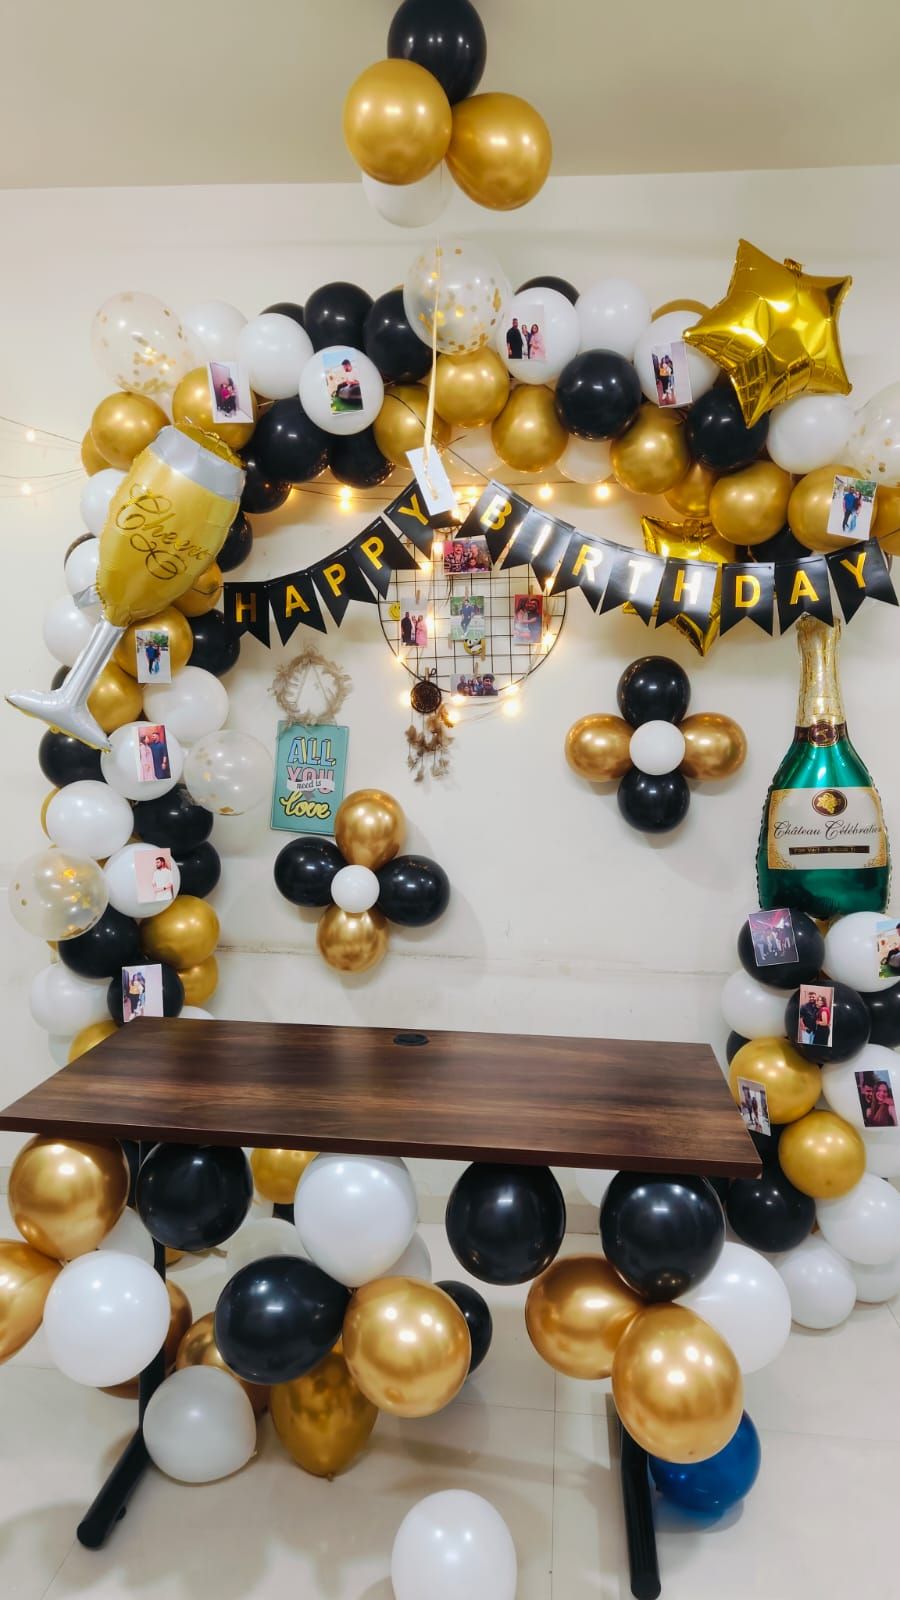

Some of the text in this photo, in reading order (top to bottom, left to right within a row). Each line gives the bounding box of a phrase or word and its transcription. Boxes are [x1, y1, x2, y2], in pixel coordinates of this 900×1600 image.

[116, 484, 209, 580] Cheers
[235, 493, 868, 623] HAPPY BIRTHDAY
[288, 736, 336, 767] ALL
[287, 766, 334, 783] YOU
[296, 781, 314, 789] need
[773, 820, 821, 839] Château
